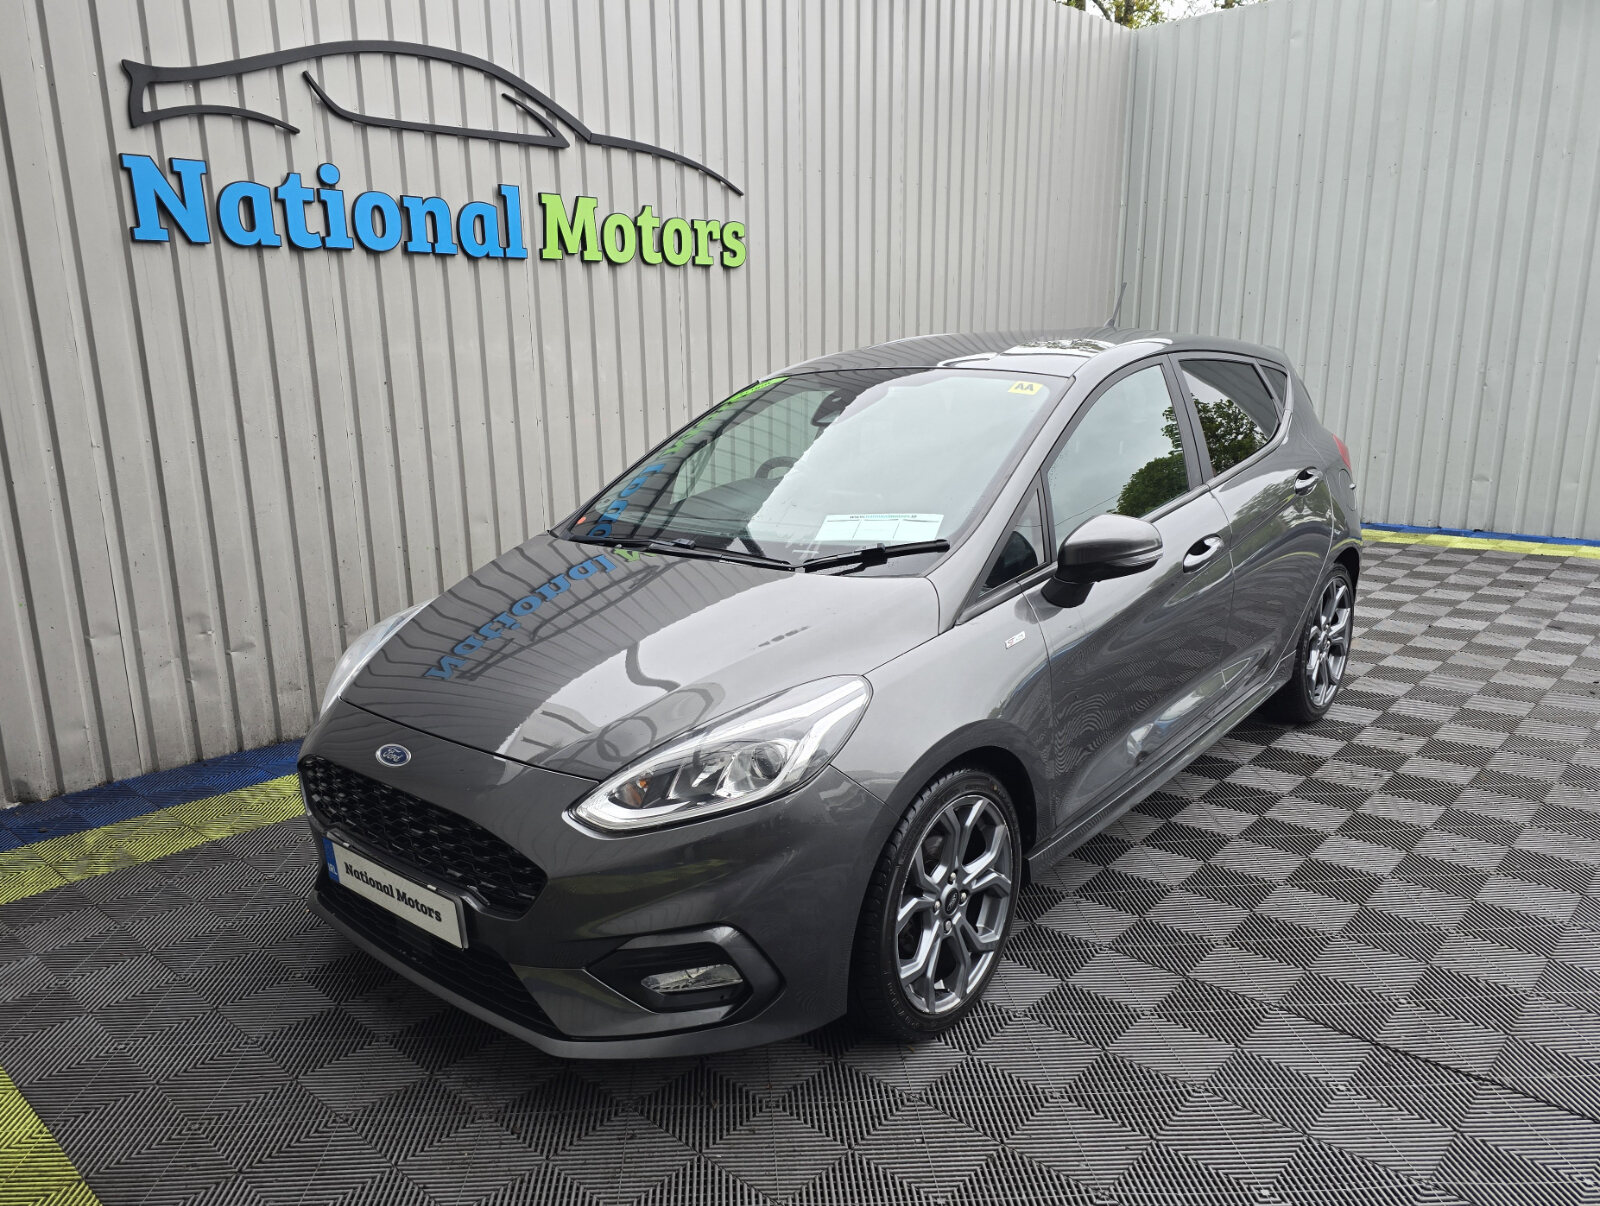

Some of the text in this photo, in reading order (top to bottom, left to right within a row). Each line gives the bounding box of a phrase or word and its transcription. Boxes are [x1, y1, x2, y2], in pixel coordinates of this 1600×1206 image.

[119, 153, 747, 268] National Motors
[1014, 383, 1034, 391] AA
[344, 862, 442, 922] National Motors
